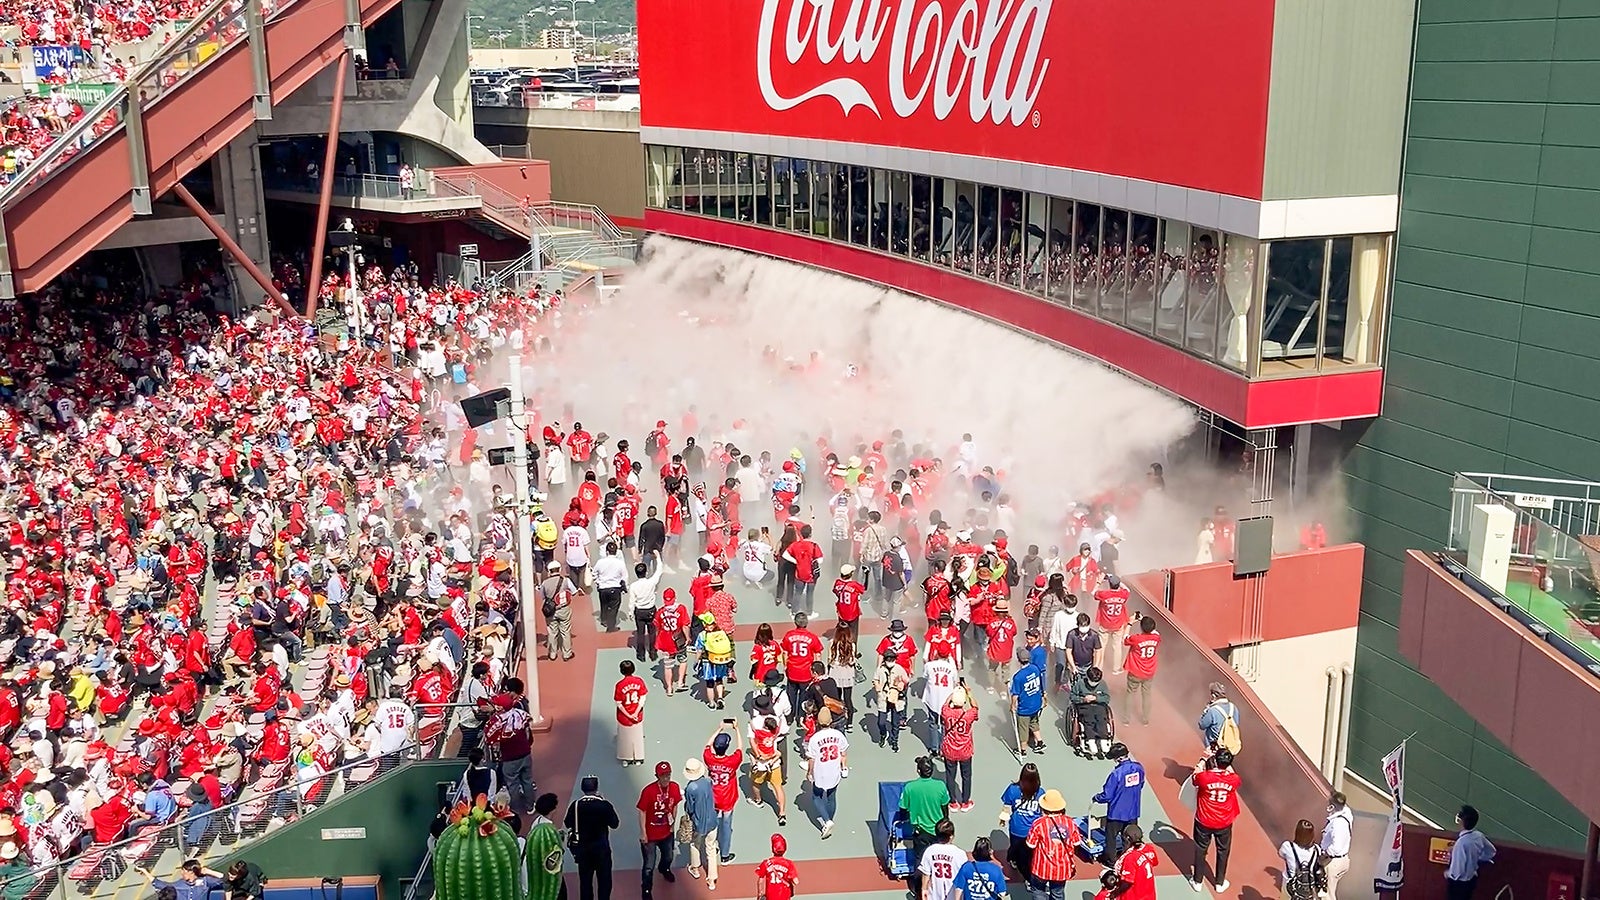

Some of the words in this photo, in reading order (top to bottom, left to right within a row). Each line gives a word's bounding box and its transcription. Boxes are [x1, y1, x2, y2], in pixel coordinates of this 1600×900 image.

[569, 537, 579, 547] 51
[1106, 604, 1122, 616] 33
[791, 642, 808, 657] 15
[934, 673, 948, 687] 14
[625, 691, 639, 705] 14
[388, 714, 404, 729] 15
[820, 745, 839, 762] 33
[711, 772, 730, 786] 33
[1209, 790, 1228, 803] 15
[933, 863, 952, 879] 33
